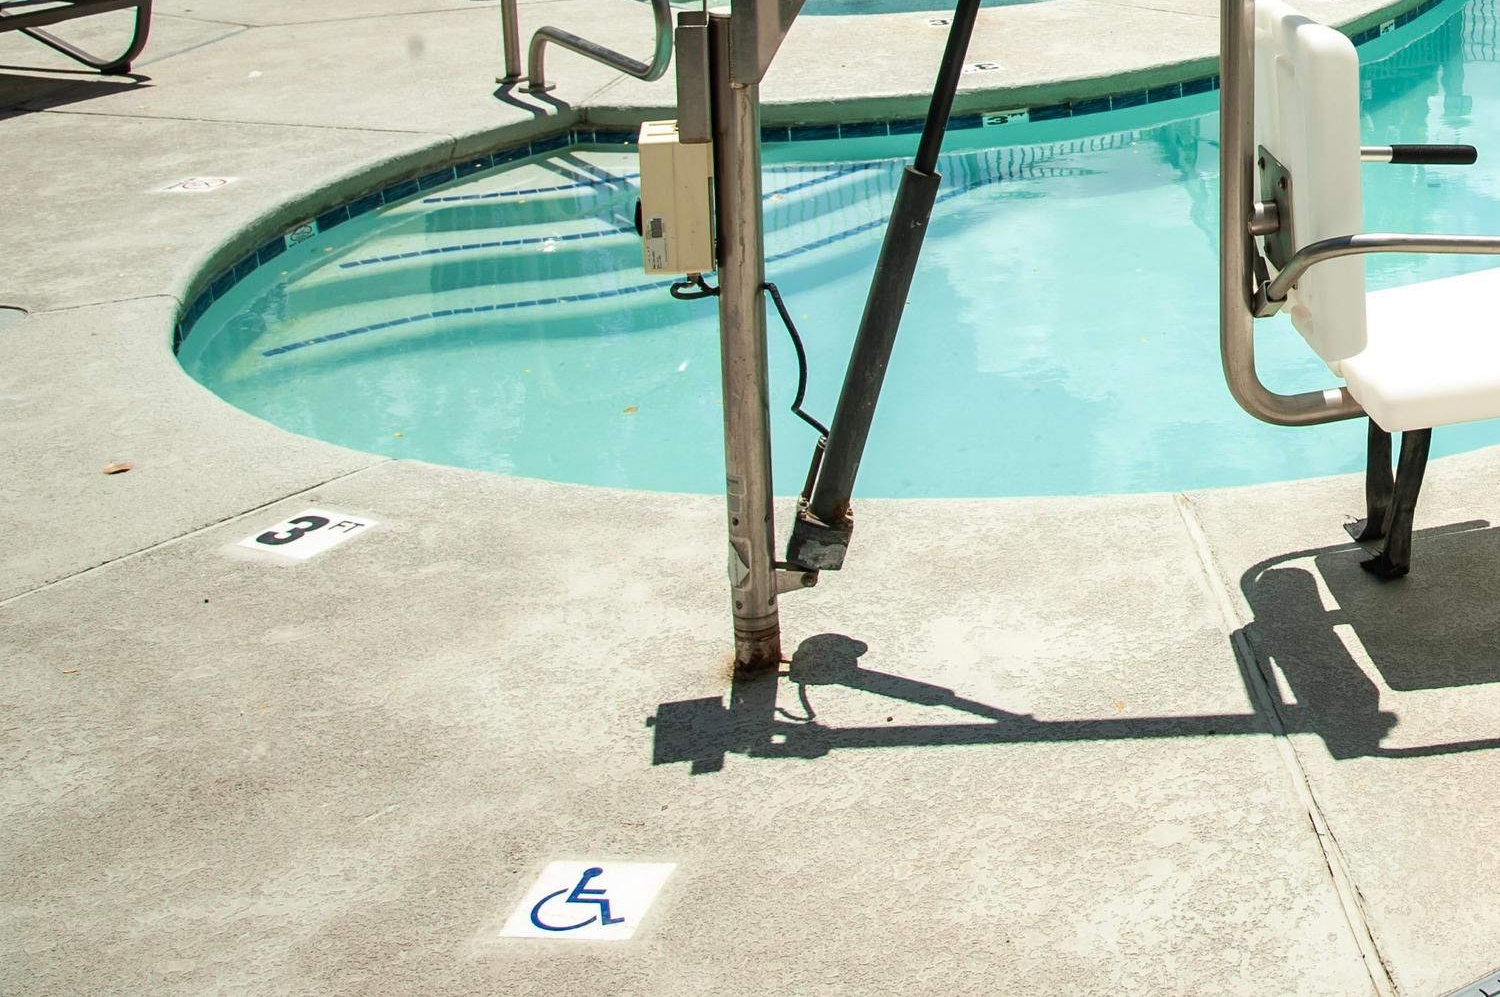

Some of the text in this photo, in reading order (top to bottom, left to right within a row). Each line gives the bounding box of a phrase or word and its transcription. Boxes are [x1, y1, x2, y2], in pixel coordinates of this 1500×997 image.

[988, 117, 1008, 126] 3
[256, 515, 366, 546] 3 FT
